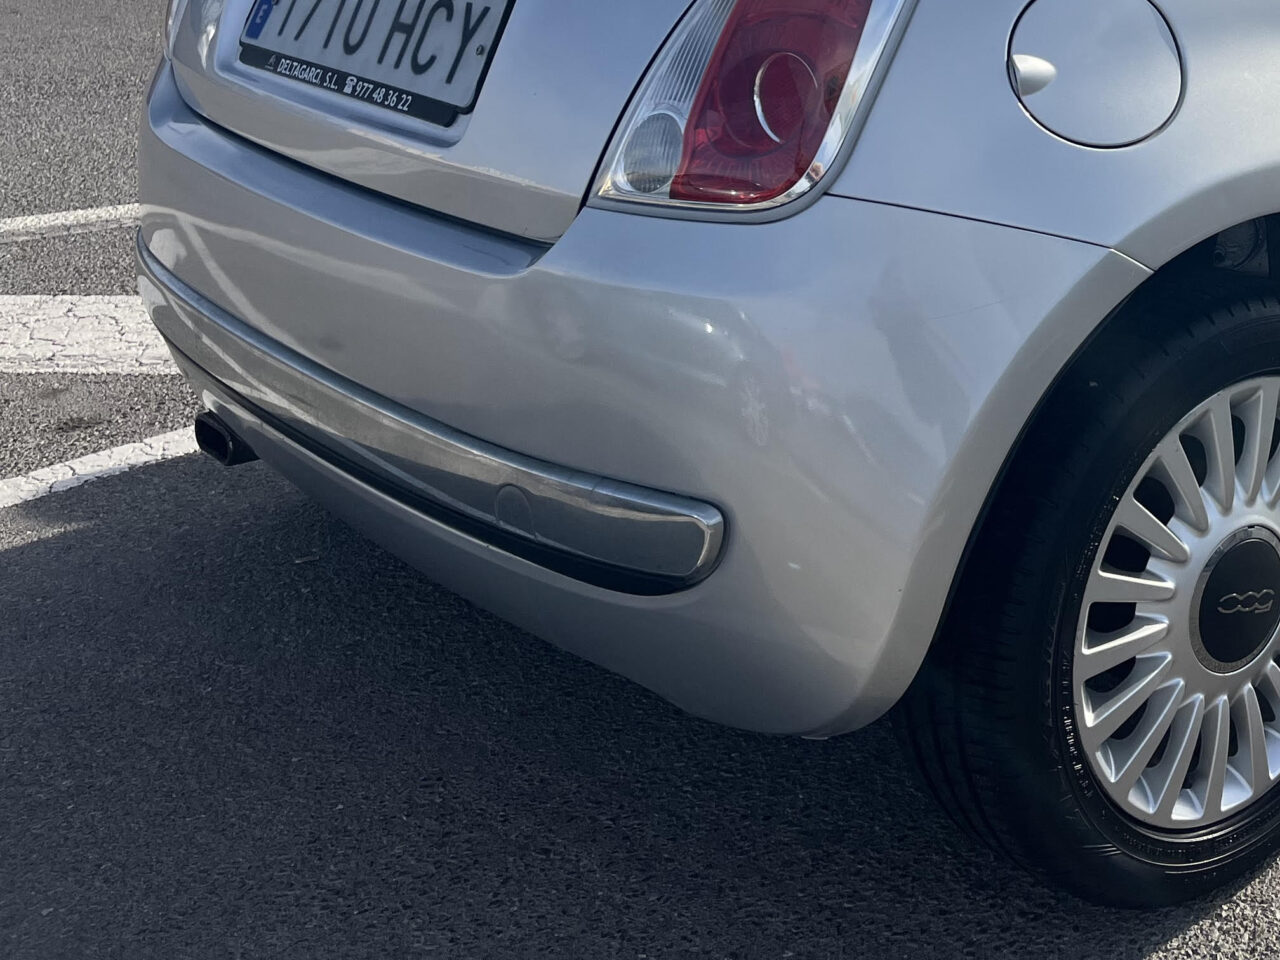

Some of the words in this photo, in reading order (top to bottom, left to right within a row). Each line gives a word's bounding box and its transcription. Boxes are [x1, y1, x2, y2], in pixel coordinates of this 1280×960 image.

[356, 82, 374, 100] 977
[372, 87, 386, 103] 48
[384, 91, 399, 107] 36
[397, 94, 413, 112] 22
